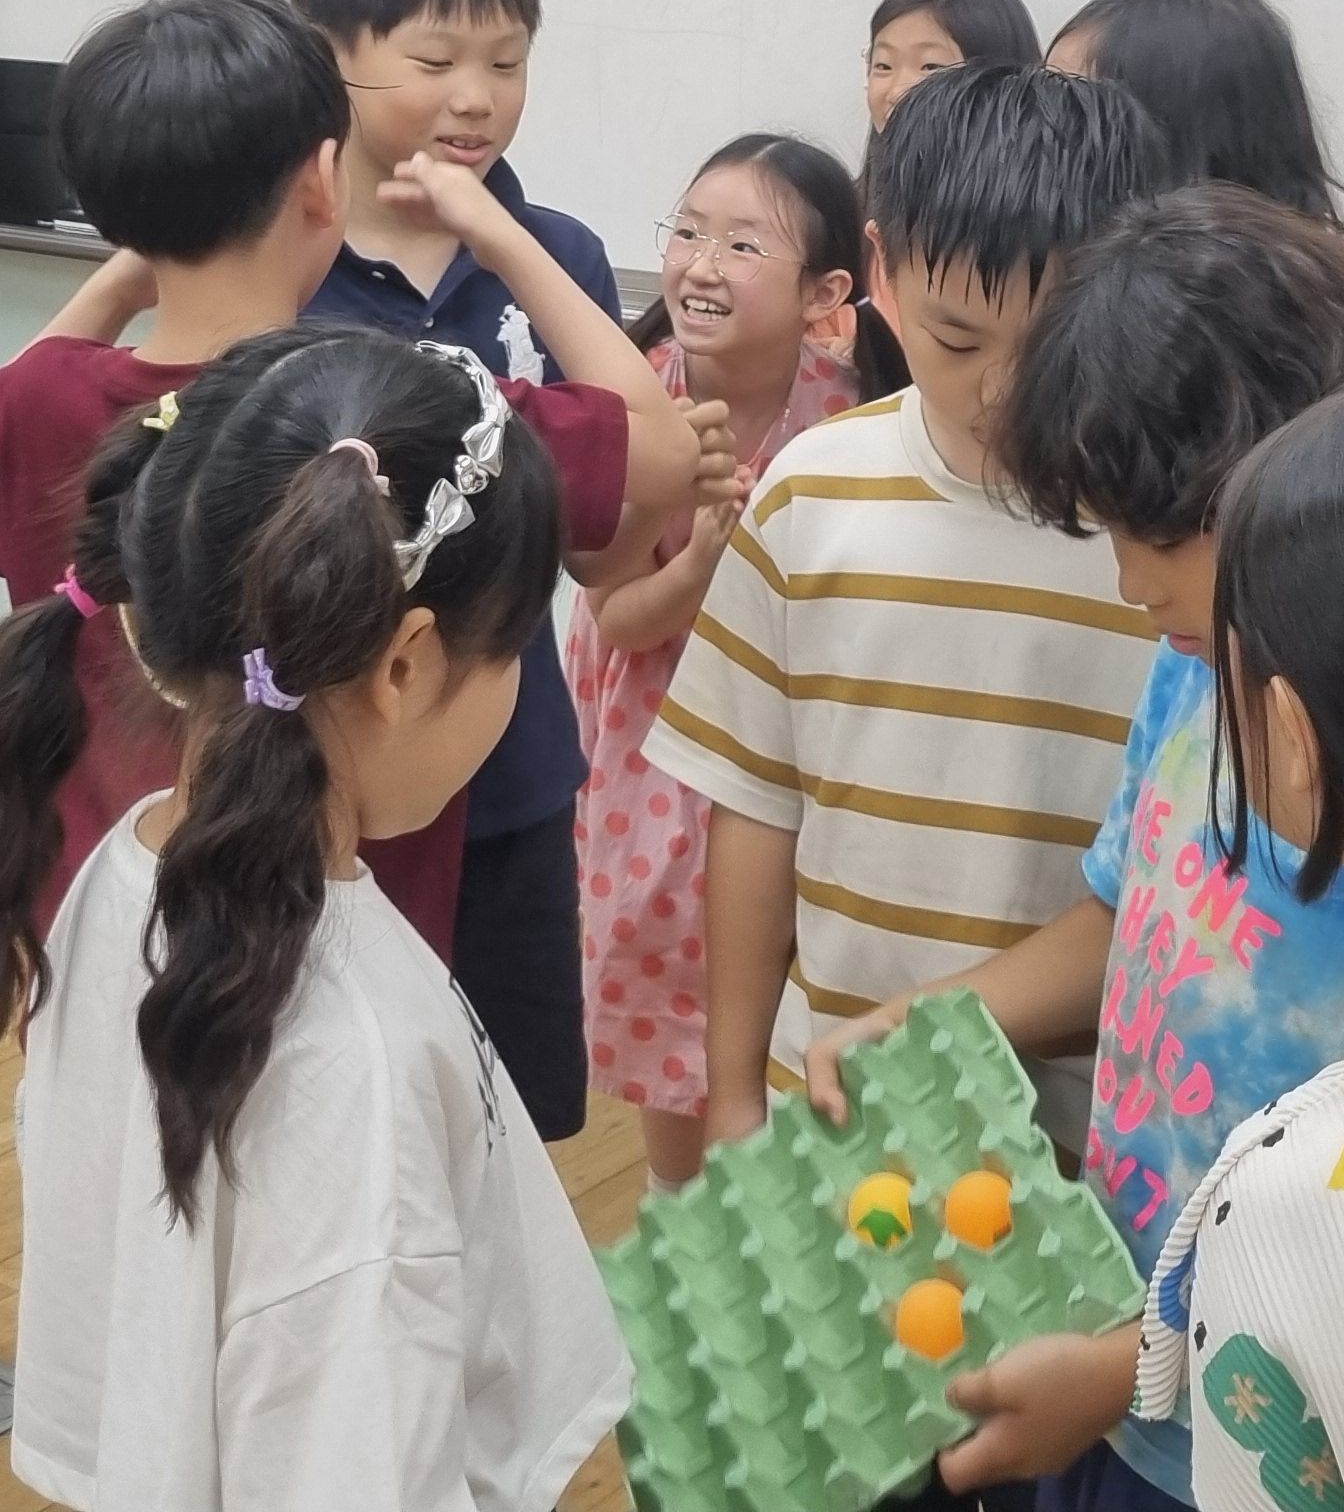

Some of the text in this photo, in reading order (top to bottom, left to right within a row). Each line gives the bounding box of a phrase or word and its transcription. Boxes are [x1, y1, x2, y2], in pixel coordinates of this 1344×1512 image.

[1120, 873, 1215, 998] HEY
[1173, 842, 1282, 971] ONE
[1098, 1059, 1156, 1134] OU
